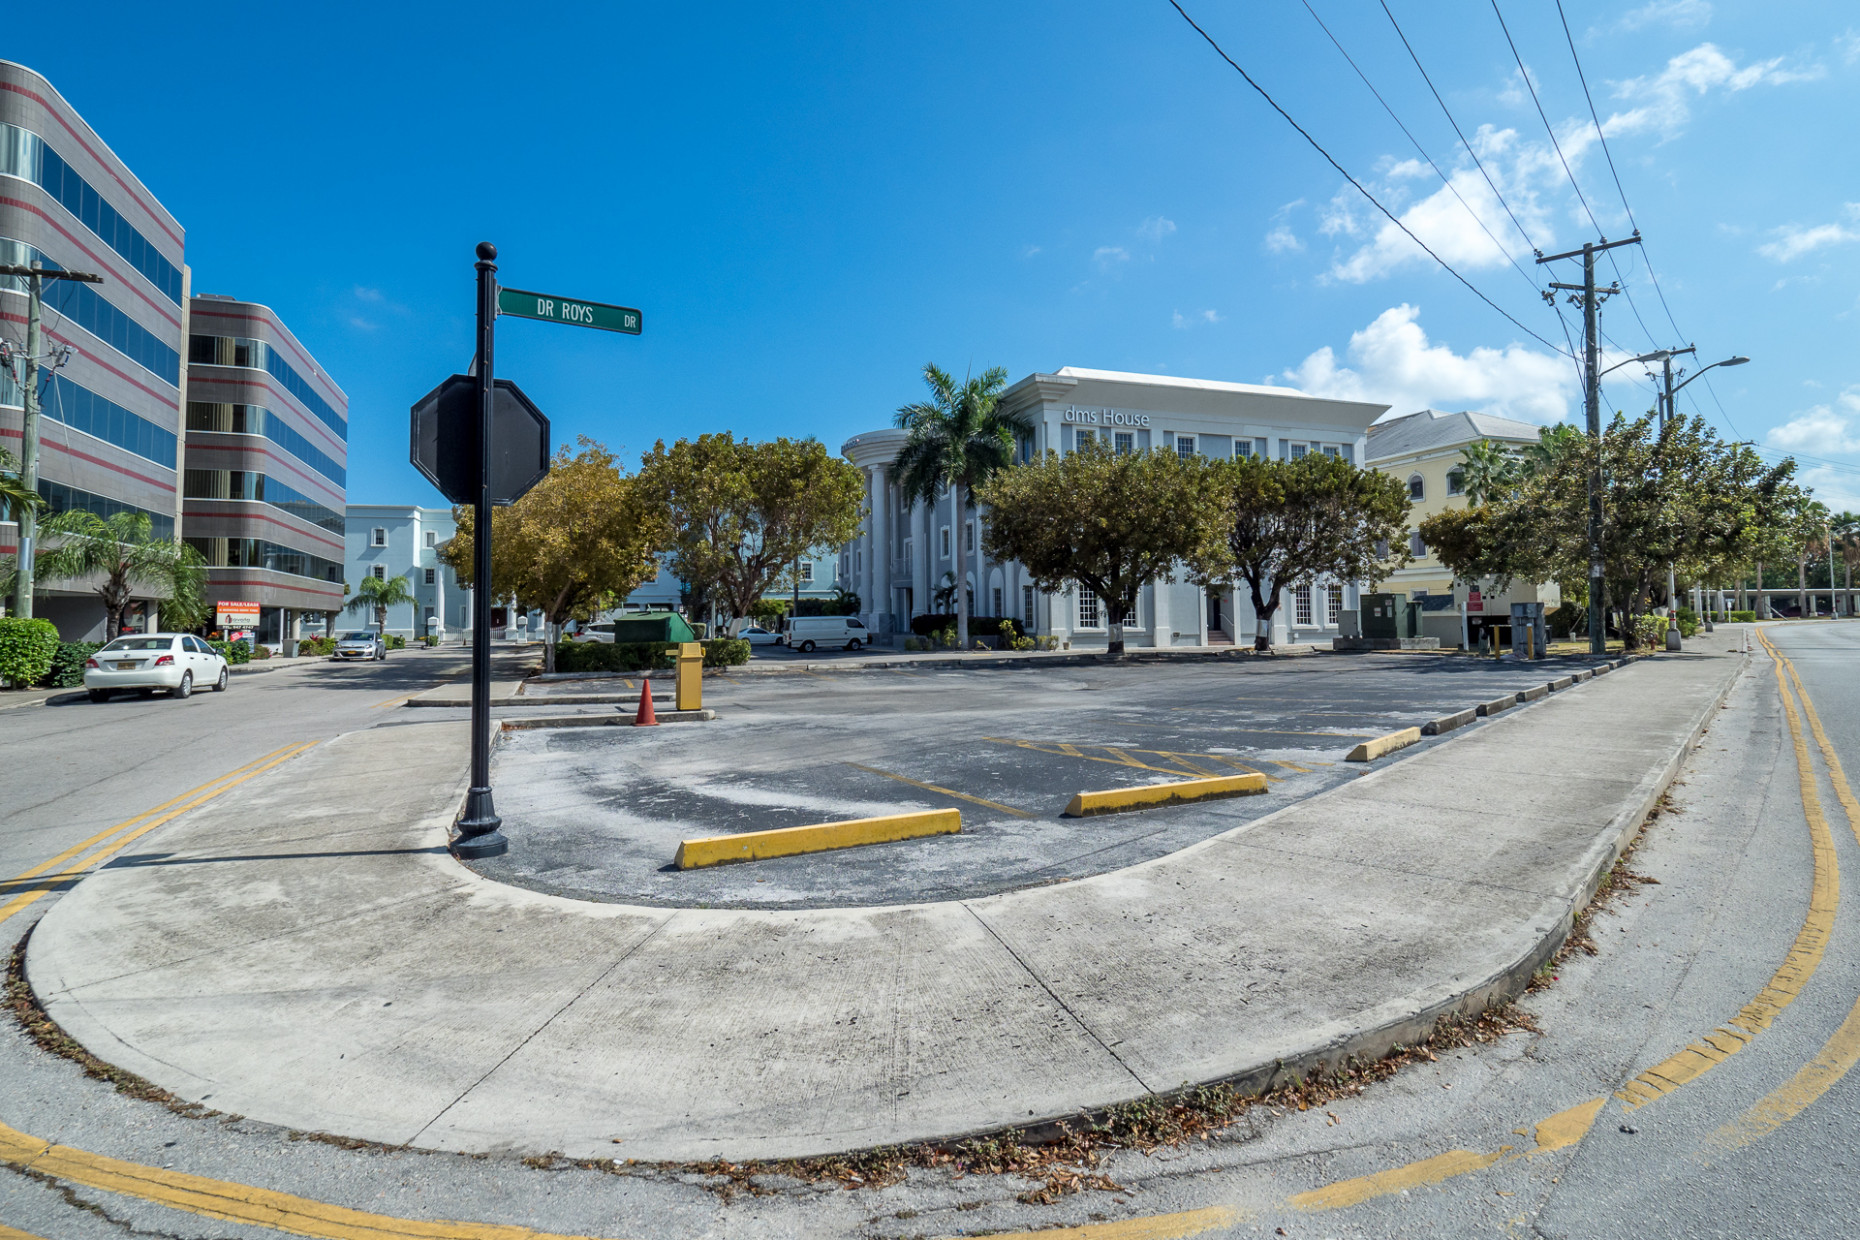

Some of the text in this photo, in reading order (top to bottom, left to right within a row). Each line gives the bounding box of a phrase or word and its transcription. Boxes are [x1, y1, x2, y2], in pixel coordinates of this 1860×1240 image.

[537, 298, 636, 328] DR ROYS DR
[1065, 405, 1149, 427] dms House
